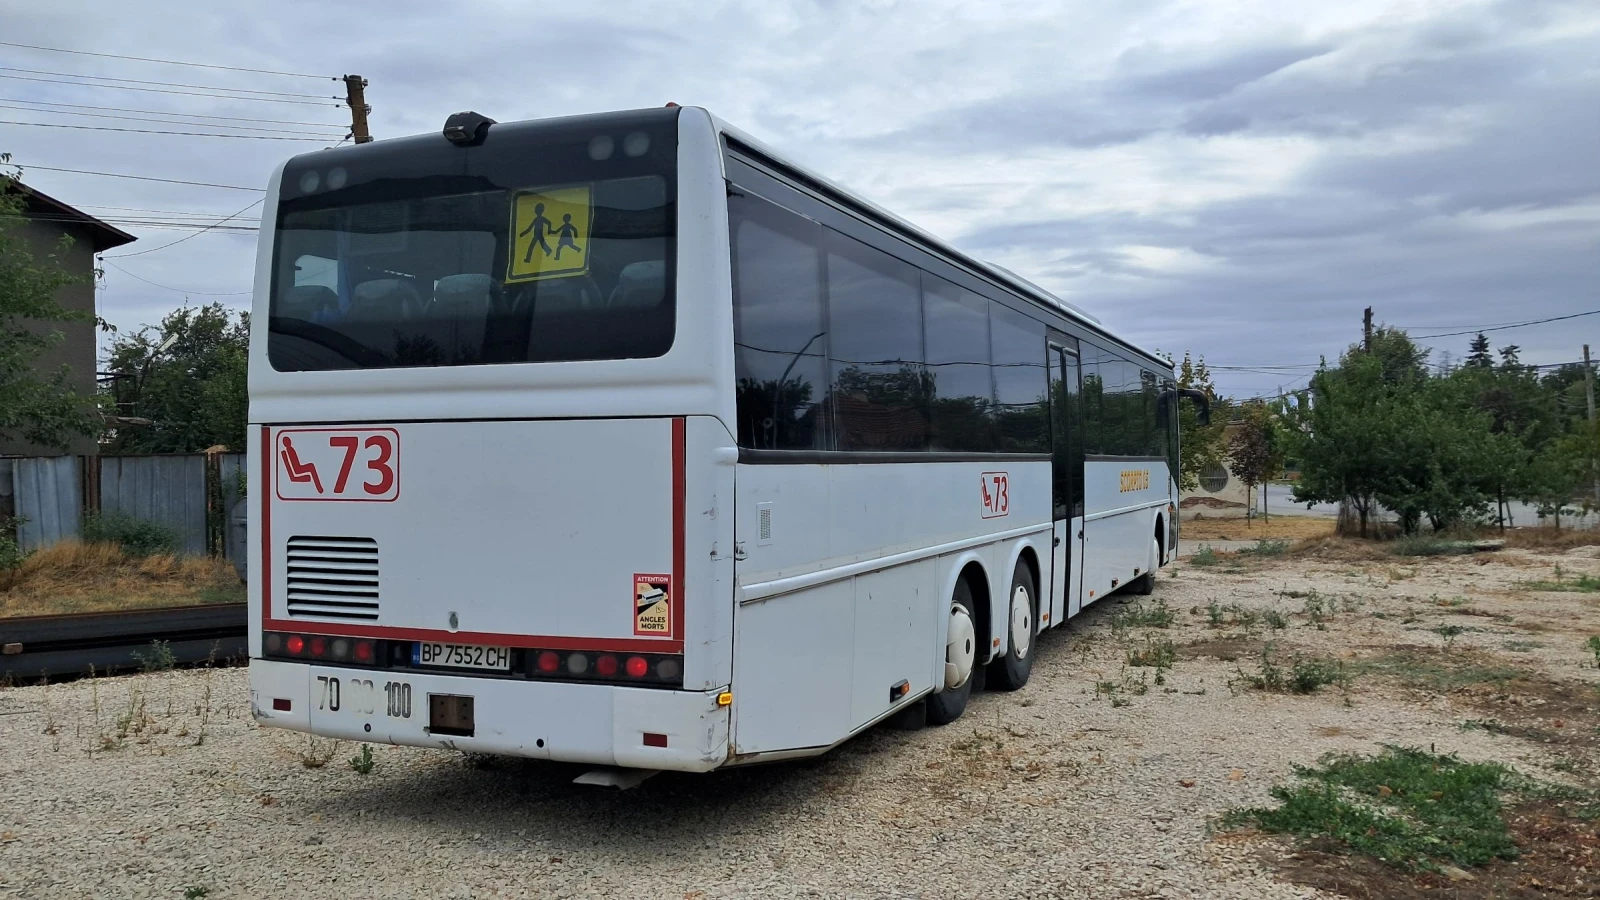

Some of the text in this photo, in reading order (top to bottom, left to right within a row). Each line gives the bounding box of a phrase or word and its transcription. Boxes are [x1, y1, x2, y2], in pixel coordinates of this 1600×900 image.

[329, 435, 394, 495] 73
[993, 476, 1008, 513] 73
[422, 643, 508, 668] BP 7552 CH
[317, 675, 340, 712] 70
[384, 681, 412, 719] 100
